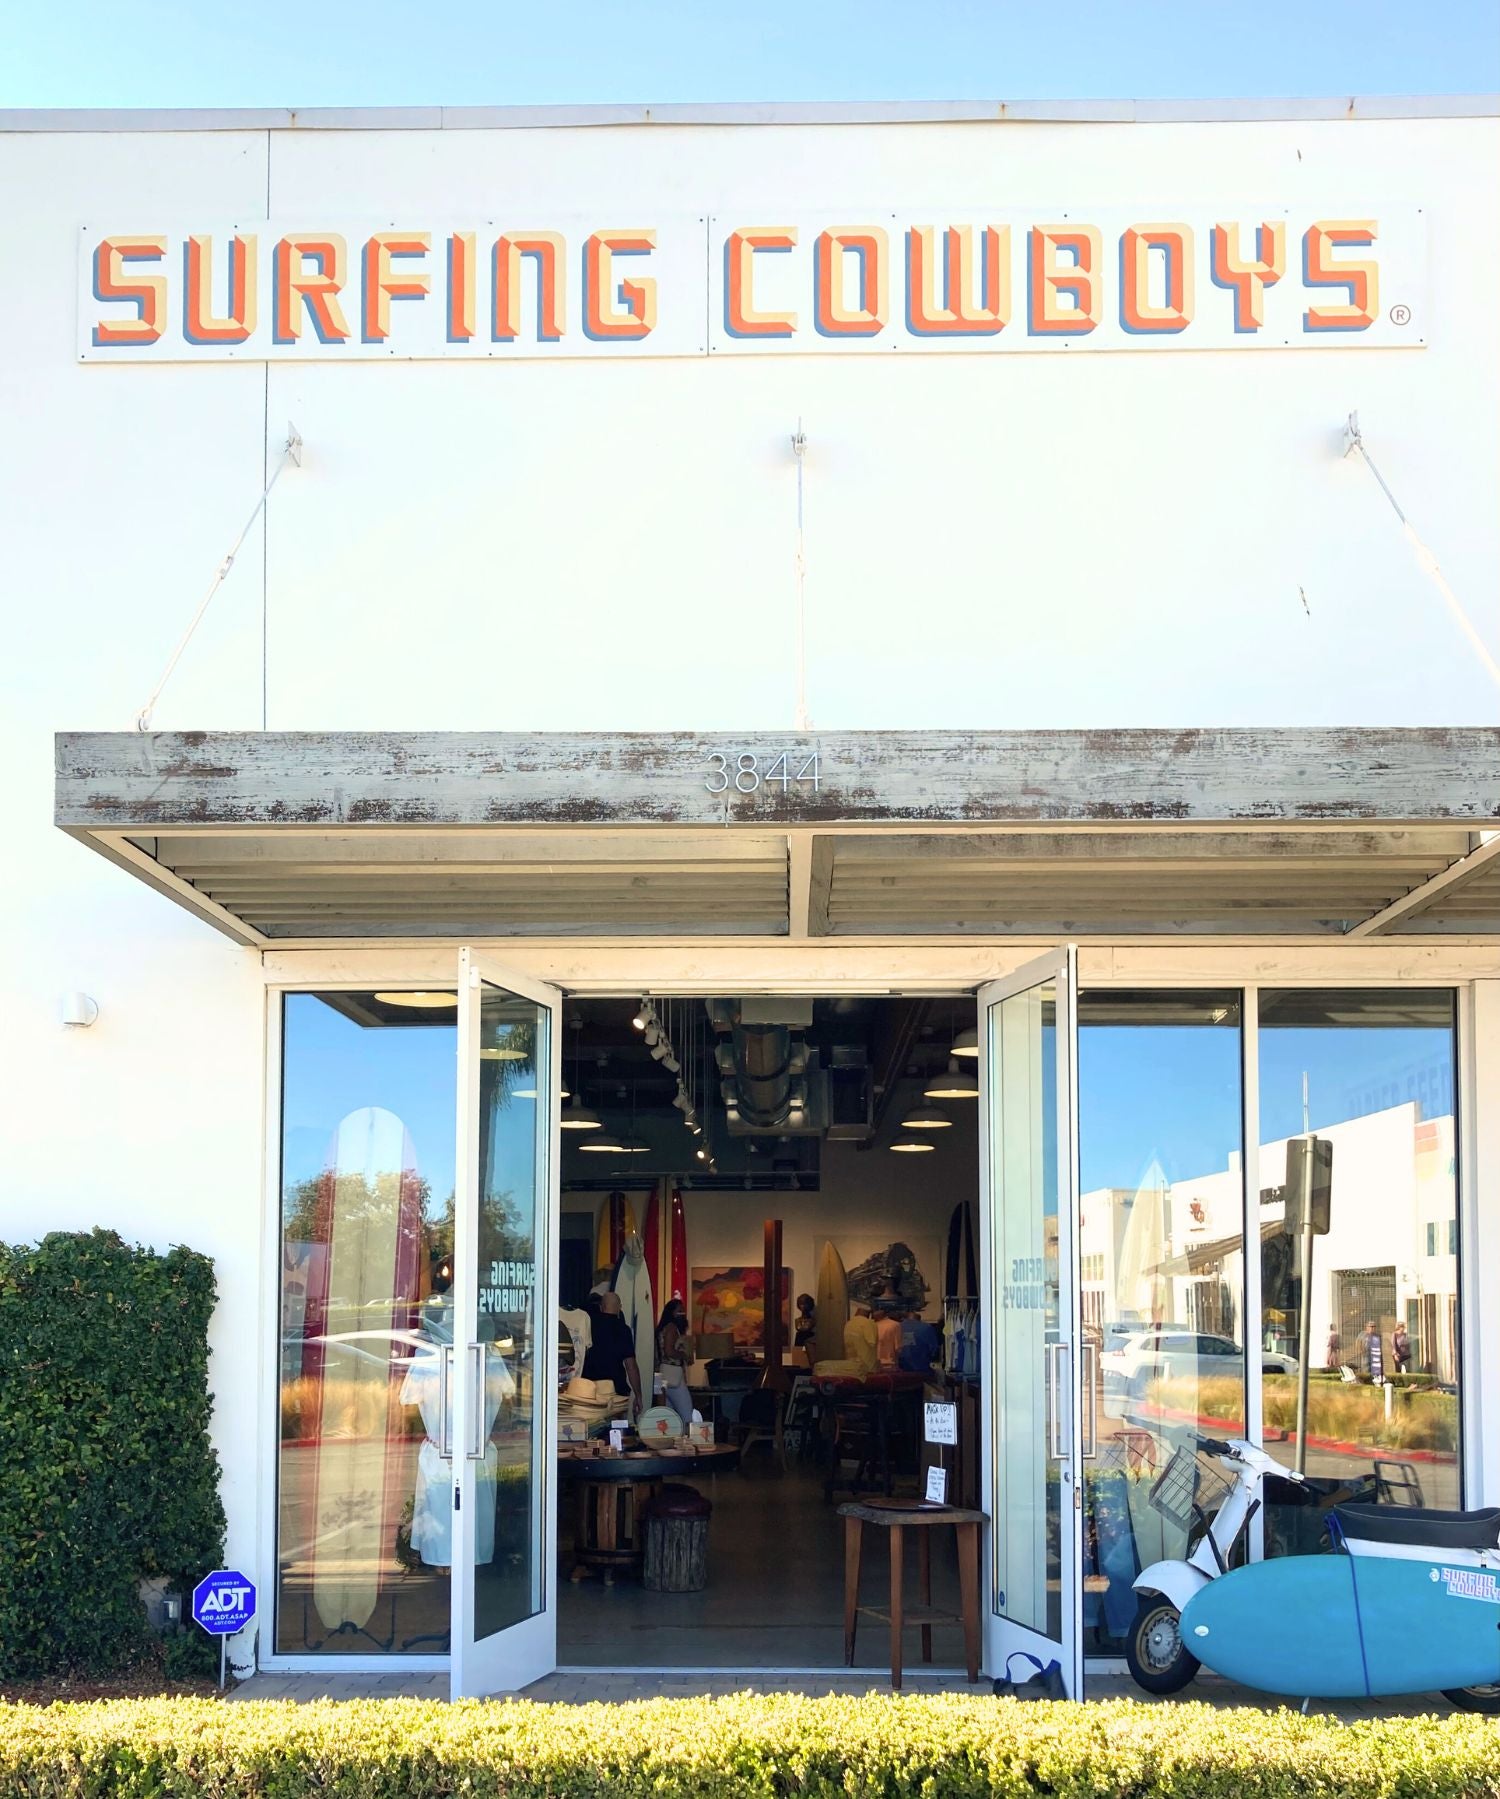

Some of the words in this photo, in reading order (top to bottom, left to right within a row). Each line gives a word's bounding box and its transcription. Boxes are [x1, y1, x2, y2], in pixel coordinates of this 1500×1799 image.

[92, 229, 658, 346] SURFING
[724, 219, 1380, 339] COWBOYS
[704, 752, 823, 793] 3844
[1442, 1568, 1495, 1588] SURFING
[200, 1587, 251, 1613] ADT
